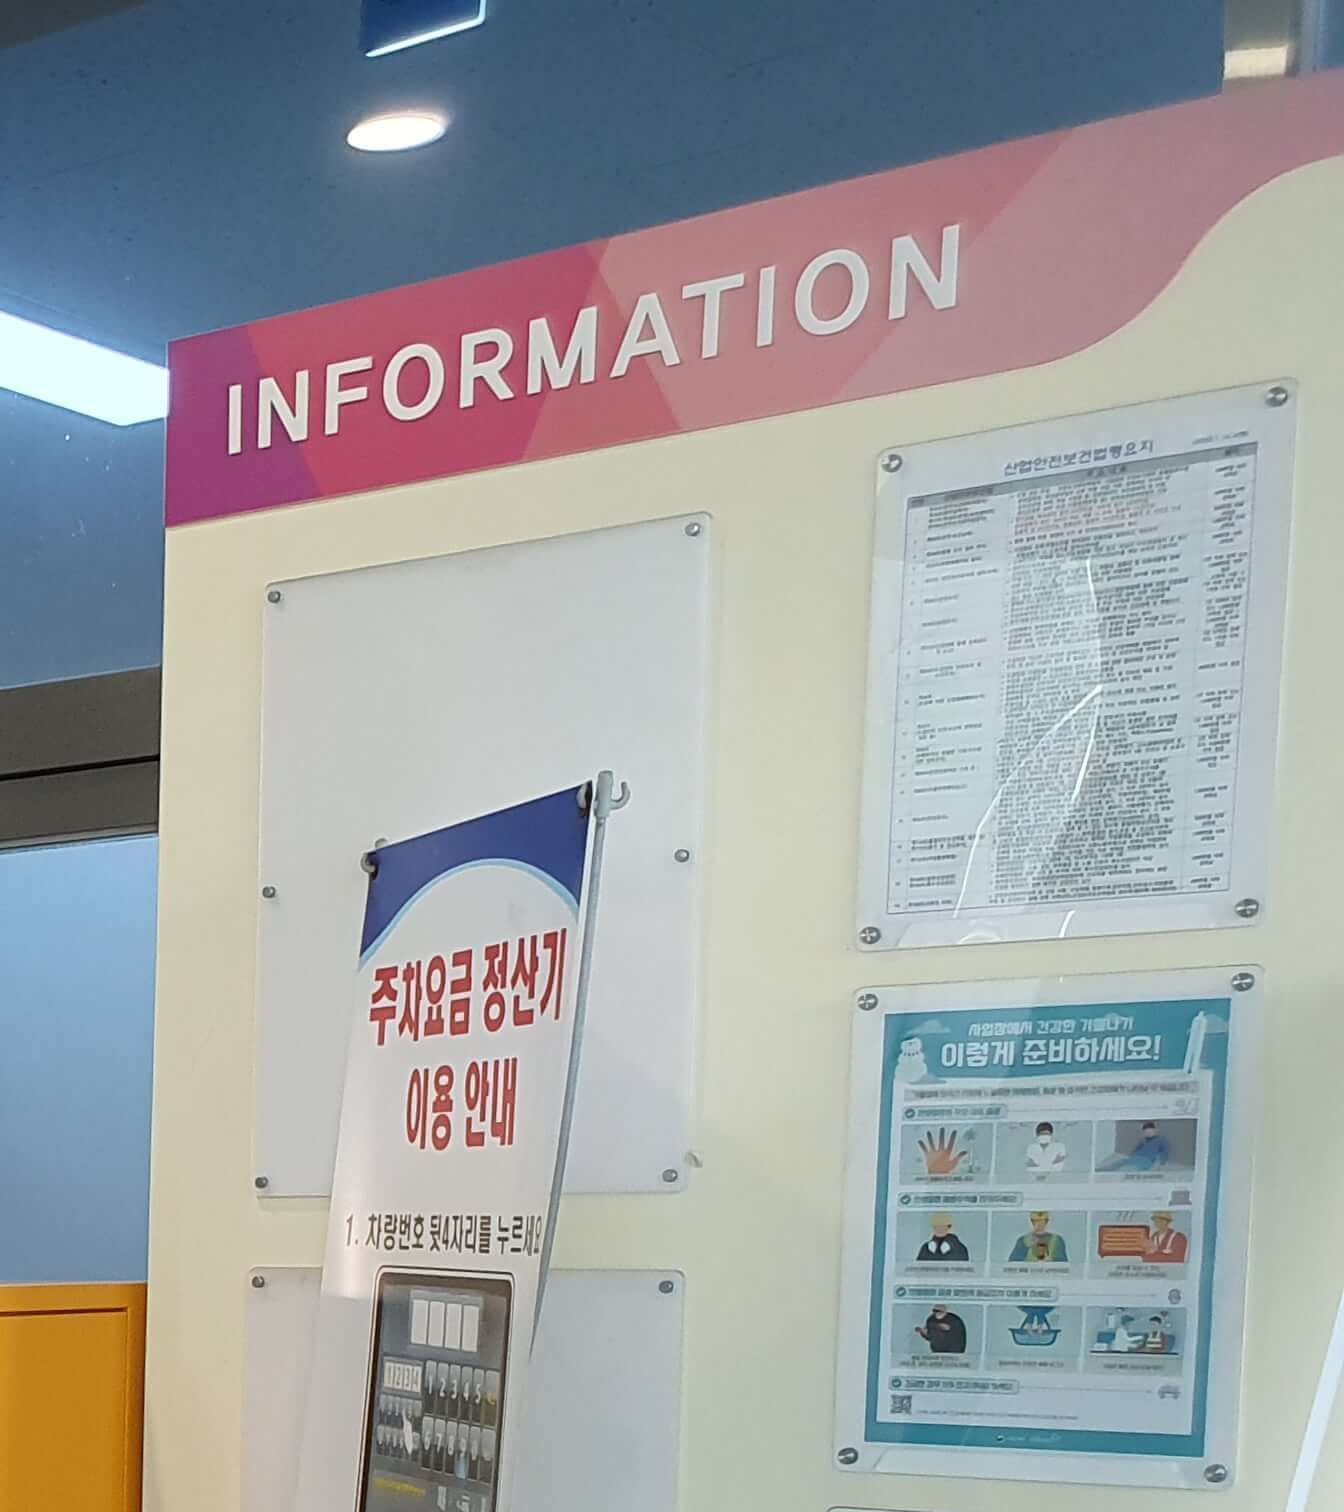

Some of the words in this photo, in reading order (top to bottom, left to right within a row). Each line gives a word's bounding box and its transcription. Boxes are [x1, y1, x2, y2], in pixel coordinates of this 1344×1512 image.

[226, 222, 961, 457] INFORMATION
[368, 947, 474, 1048] 주차요금
[482, 926, 569, 1034] 정산기
[940, 1040, 1015, 1069] 이렇게
[1022, 1034, 1162, 1067] 준비하세요!
[405, 1063, 455, 1152] 이용
[465, 1055, 519, 1150] 안내
[344, 1213, 360, 1246] 1.
[365, 1212, 426, 1253] 차량번호
[495, 1213, 543, 1259] 누르세요
